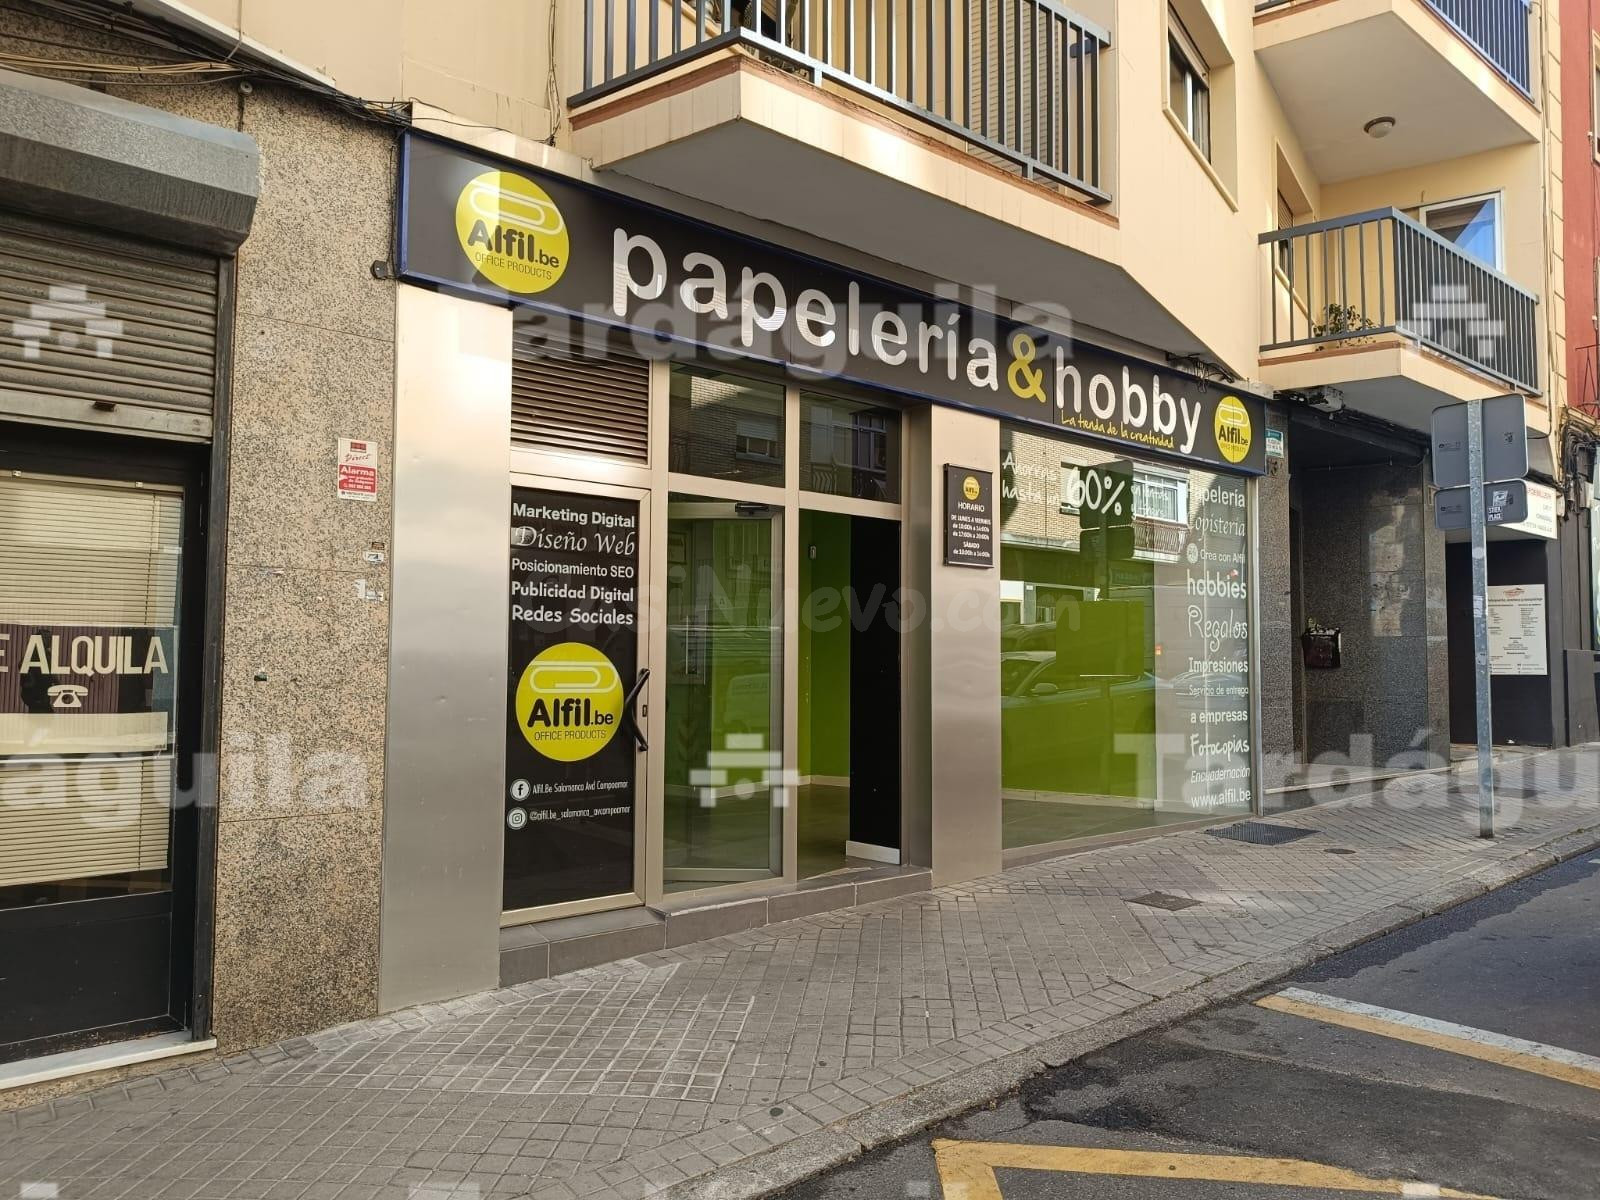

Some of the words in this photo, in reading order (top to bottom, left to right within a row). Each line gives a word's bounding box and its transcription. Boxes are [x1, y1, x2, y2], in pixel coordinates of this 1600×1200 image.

[467, 219, 560, 268] Alfil.be
[475, 252, 505, 268] OFFICE
[507, 261, 552, 280] PRODUCTS
[613, 228, 999, 393] papelería
[1007, 333, 1046, 403] &
[1056, 345, 1201, 454] hobby
[1062, 410, 1076, 426] La
[1078, 413, 1105, 433] tienda
[1107, 421, 1118, 436] de
[1121, 421, 1129, 439] la
[957, 501, 985, 513] HORARIO
[1190, 484, 1245, 508] apelería
[513, 502, 588, 526] Marketing
[591, 511, 635, 528] Digital
[514, 525, 588, 552] Diseño
[594, 531, 636, 555] Web
[511, 557, 608, 577] Posicionamiento
[610, 565, 634, 578] SEO
[1200, 549, 1217, 561] Crea
[1218, 552, 1232, 563] con
[511, 581, 586, 599] Publicidad
[590, 586, 634, 604] Digital
[1187, 568, 1247, 599] hobbies
[512, 604, 562, 623] Redes
[569, 607, 633, 625] Sociales
[1188, 604, 1248, 652] Regalos
[20, 633, 169, 676] ALQUILA
[1188, 656, 1249, 677] Impresiones
[1216, 682, 1225, 695] de
[1226, 685, 1249, 697] entrega
[527, 698, 613, 728] Alfil.be
[1190, 712, 1197, 724] a
[1199, 710, 1248, 725] empresas
[534, 731, 563, 741] OFFICE
[565, 729, 607, 740] PRODUCTS
[1190, 732, 1250, 762] Fotocopias
[1190, 765, 1251, 784] Encuadernación
[554, 782, 585, 793] Salamanca
[585, 780, 596, 791] Avd
[597, 780, 629, 790] Campoamor
[1190, 787, 1251, 808] www.alfil.be
